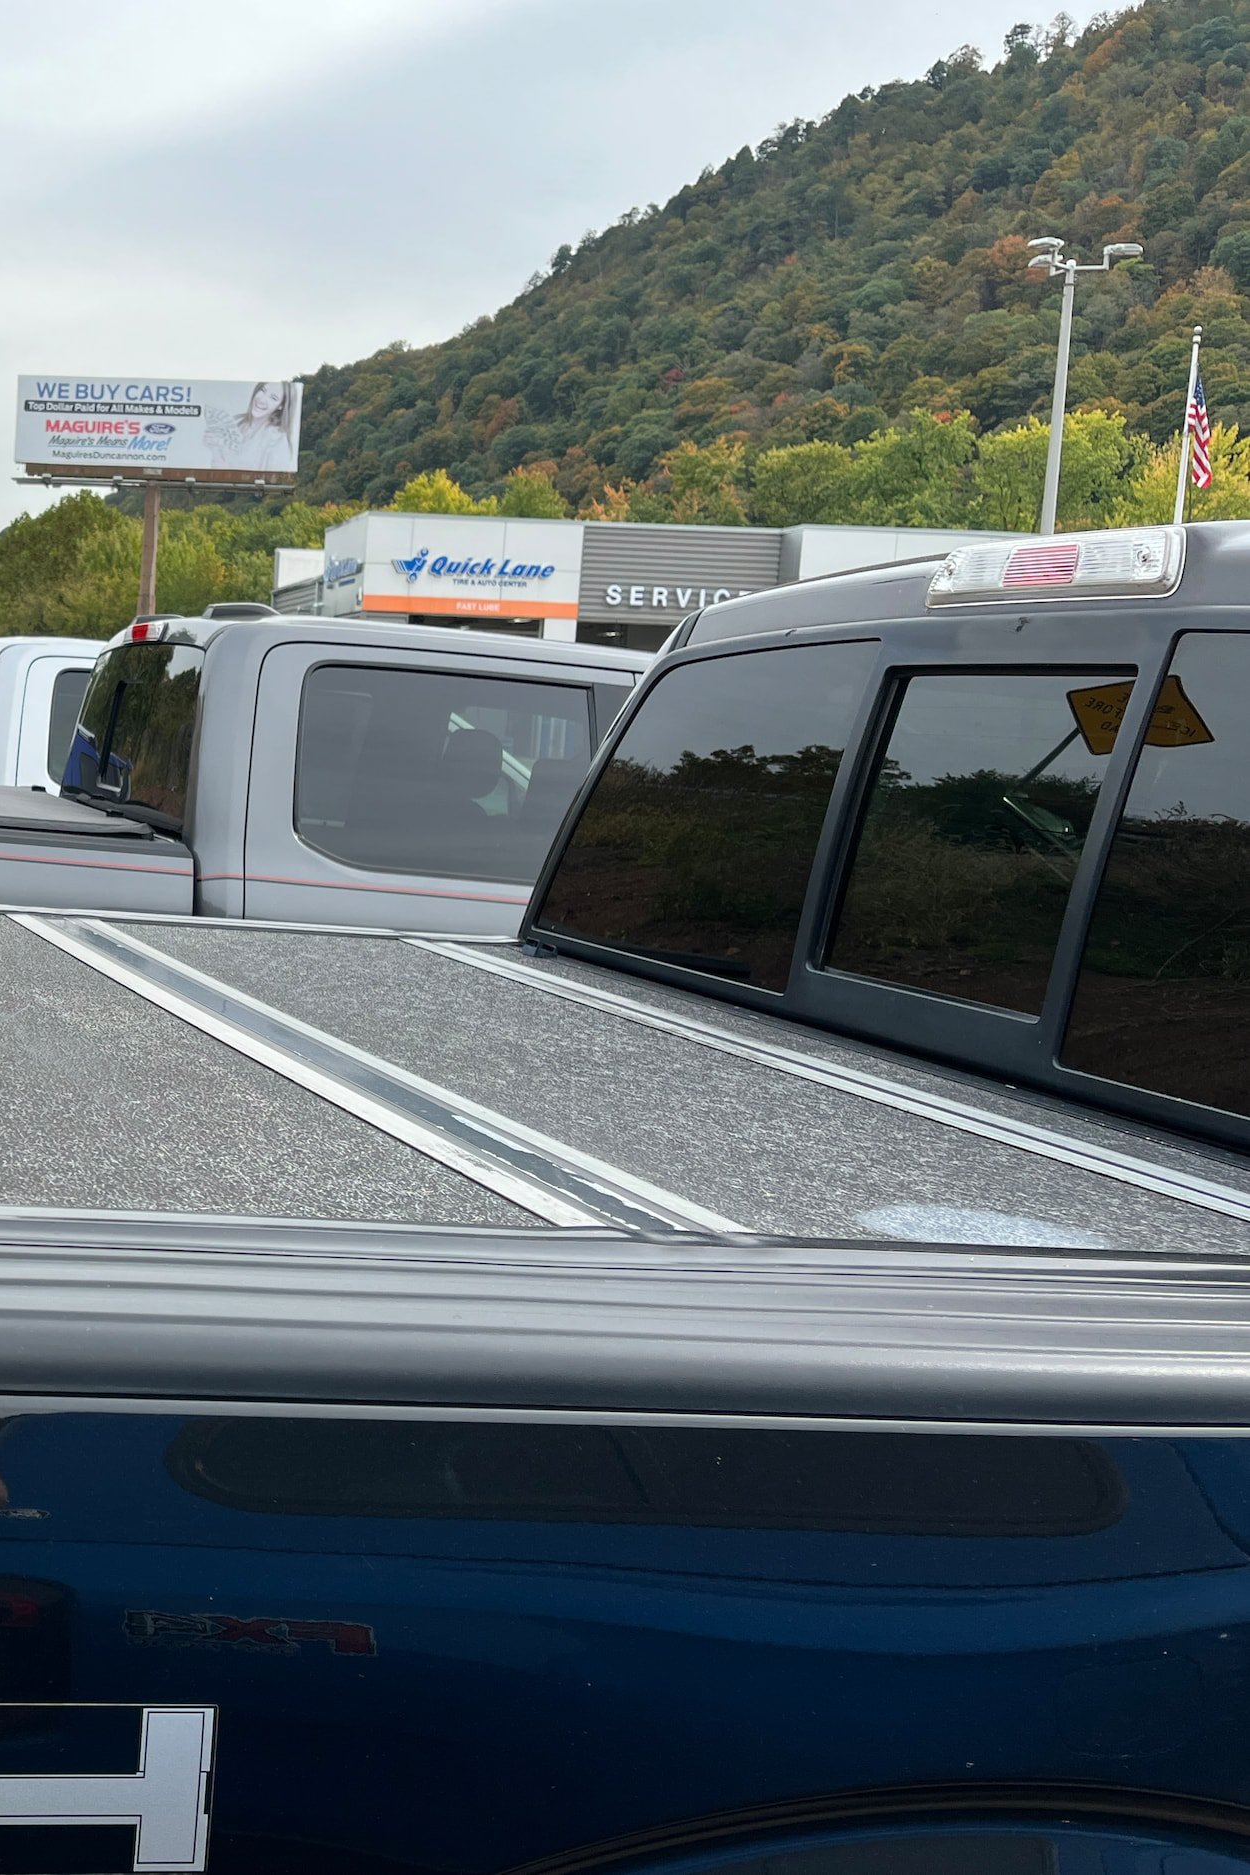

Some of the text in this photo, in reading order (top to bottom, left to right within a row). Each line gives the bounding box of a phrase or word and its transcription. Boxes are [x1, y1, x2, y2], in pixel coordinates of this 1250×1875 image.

[36, 382, 192, 403] WE BUY CARS!
[28, 402, 199, 416] Top Dollar Paid for All Makes & Models
[45, 419, 141, 435] MAGUIRE'S
[48, 435, 172, 451] Maguire's Means More!
[52, 449, 167, 462] MaguiresDuncannon.com
[429, 556, 555, 579] Quick Lane
[452, 578, 469, 586] TIRE
[477, 579, 496, 587] AUTO
[498, 580, 527, 588] CENTER
[605, 584, 753, 609] SERVIC
[456, 602, 477, 611] FAST
